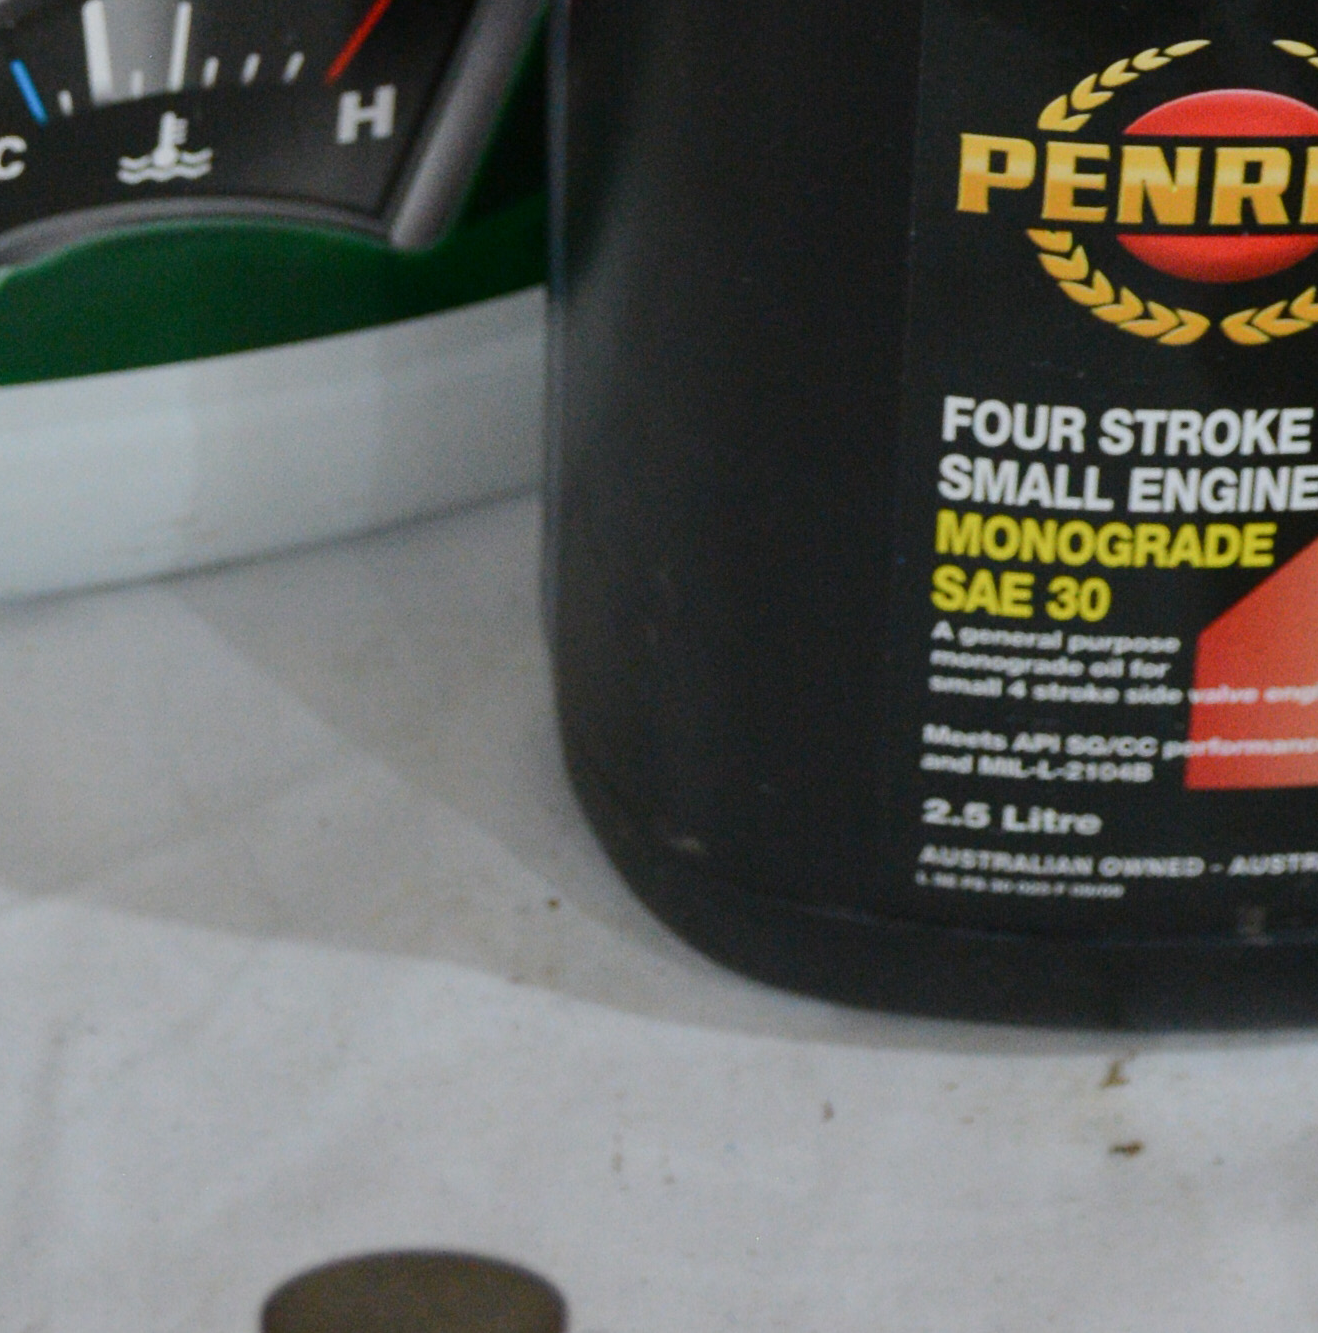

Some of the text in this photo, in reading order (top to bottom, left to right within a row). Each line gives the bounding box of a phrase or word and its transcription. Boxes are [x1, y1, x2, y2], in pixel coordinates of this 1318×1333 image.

[334, 83, 399, 143] H
[940, 394, 1316, 458] FOUR STROKE
[936, 453, 1116, 512] SMALL
[934, 508, 1278, 569] MONOGRADE
[930, 564, 1112, 623] SAE 30
[930, 619, 1182, 657] A general purpose
[929, 648, 1173, 680] monograde oil for
[928, 674, 1004, 699] small
[1005, 678, 1028, 700] 4
[1031, 681, 1121, 704] stroke
[1123, 683, 1184, 706] side
[1186, 683, 1260, 706] valve
[921, 722, 1009, 752] Meets
[1011, 730, 1062, 755] API
[919, 751, 974, 775] and
[921, 796, 1104, 836] 2.5 Litre
[917, 843, 1095, 877] AUSTRALIAN
[1096, 854, 1207, 878] OWNED
